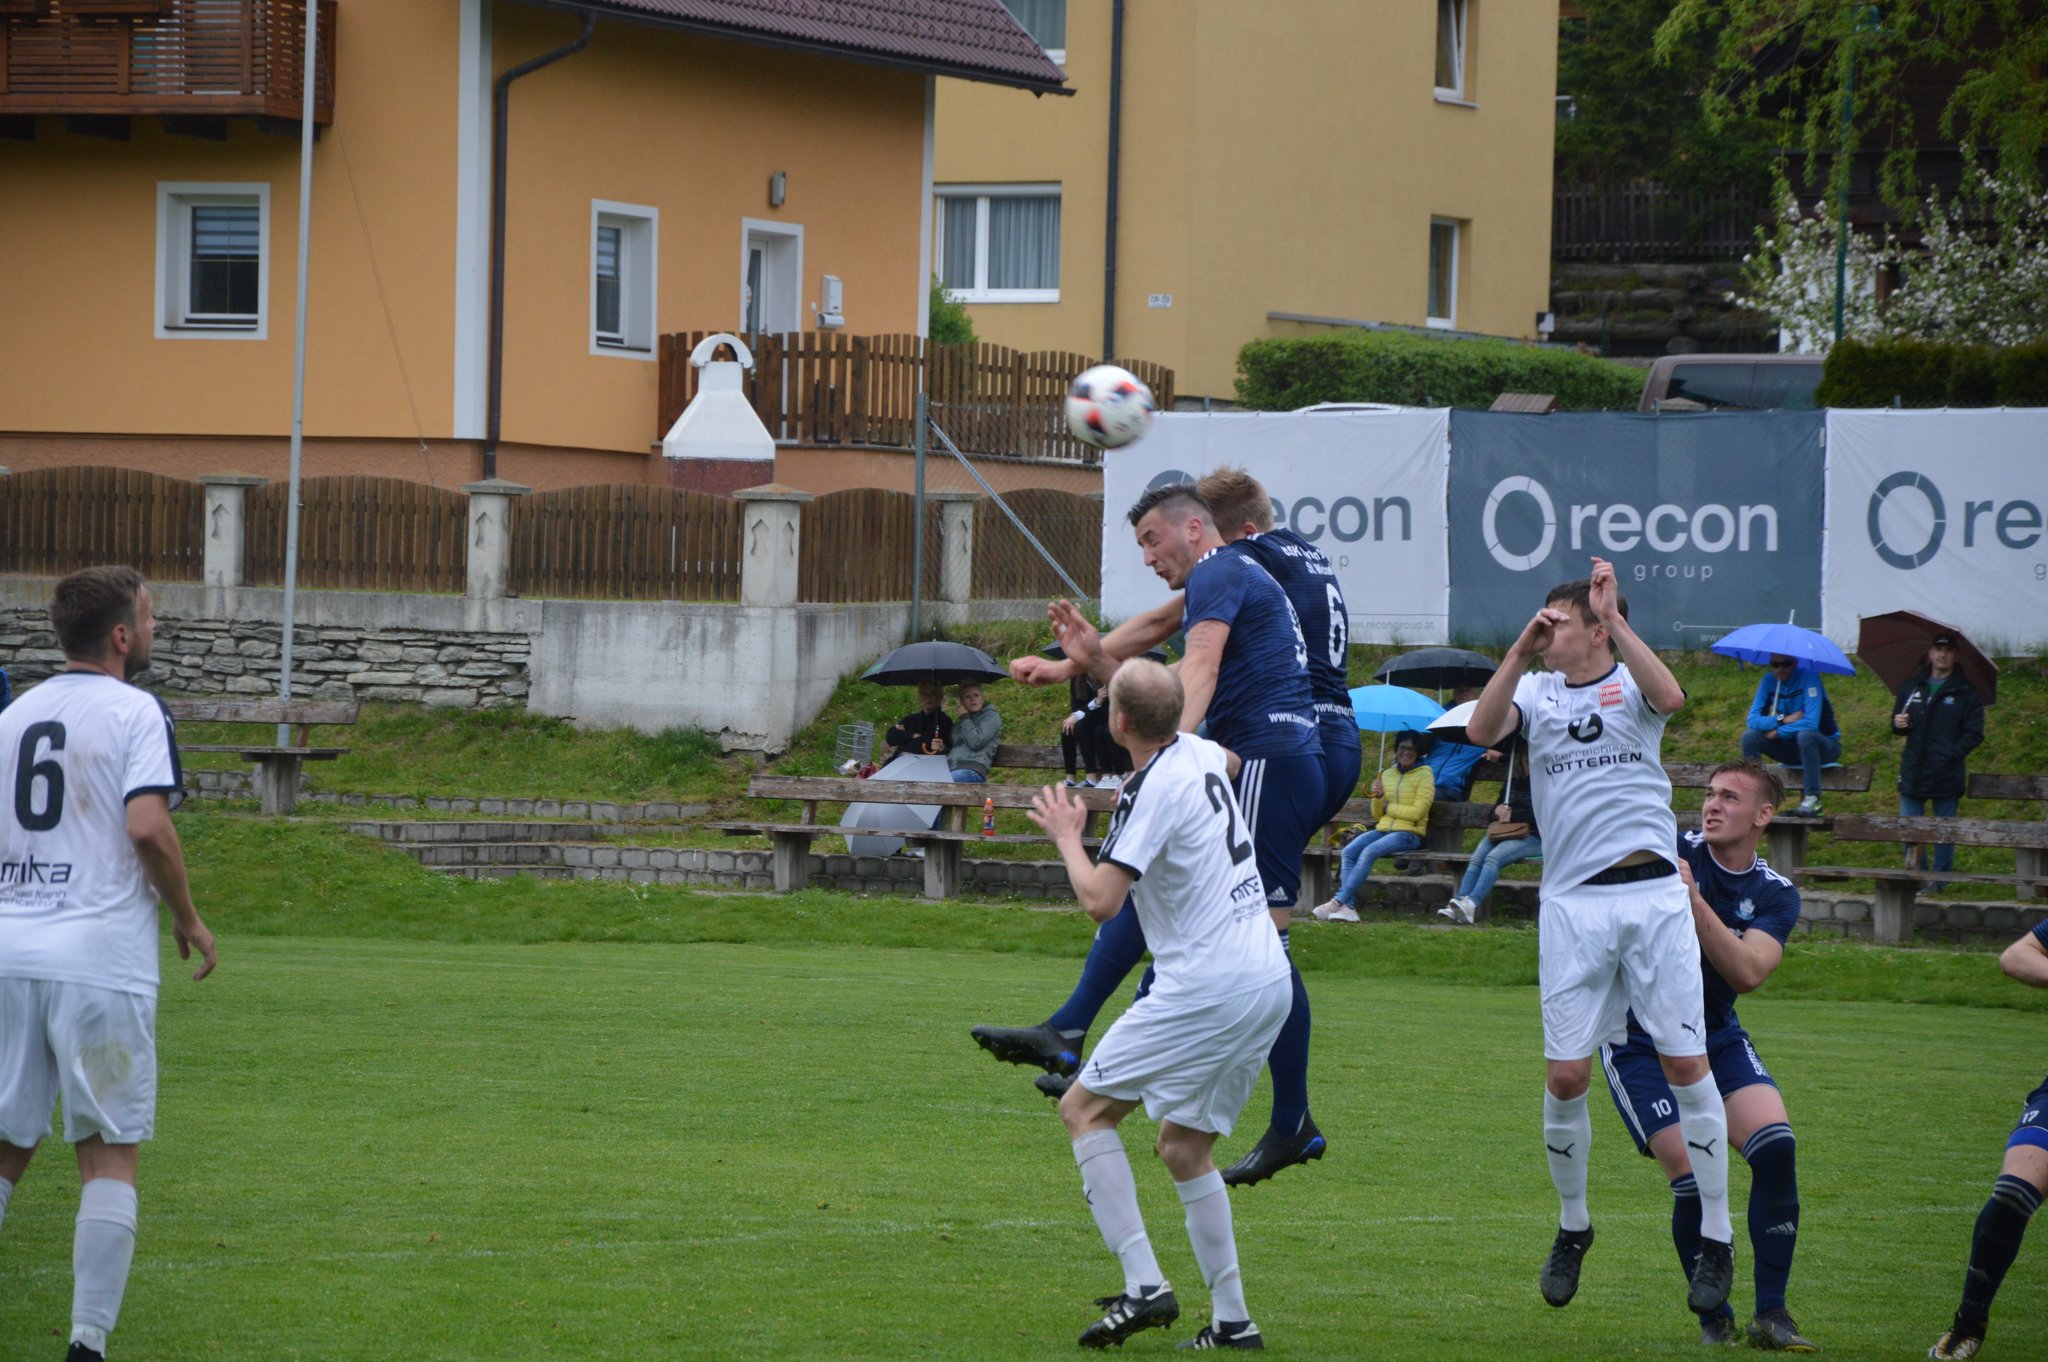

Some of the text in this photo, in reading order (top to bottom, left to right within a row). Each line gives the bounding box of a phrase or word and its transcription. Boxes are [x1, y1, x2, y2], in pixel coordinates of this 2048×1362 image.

[1270, 496, 1412, 543] con
[1570, 503, 1779, 553] recon
[1963, 499, 2048, 550] re
[1634, 564, 1714, 582] group
[1326, 583, 1346, 668] 6
[1348, 621, 1435, 632] ww.recongroup.at
[14, 720, 67, 832] 6
[1546, 752, 1643, 775] LOTTERIEN
[1205, 772, 1253, 867] 2
[1651, 1098, 1672, 1118] 10
[2022, 1110, 2040, 1123] 17
